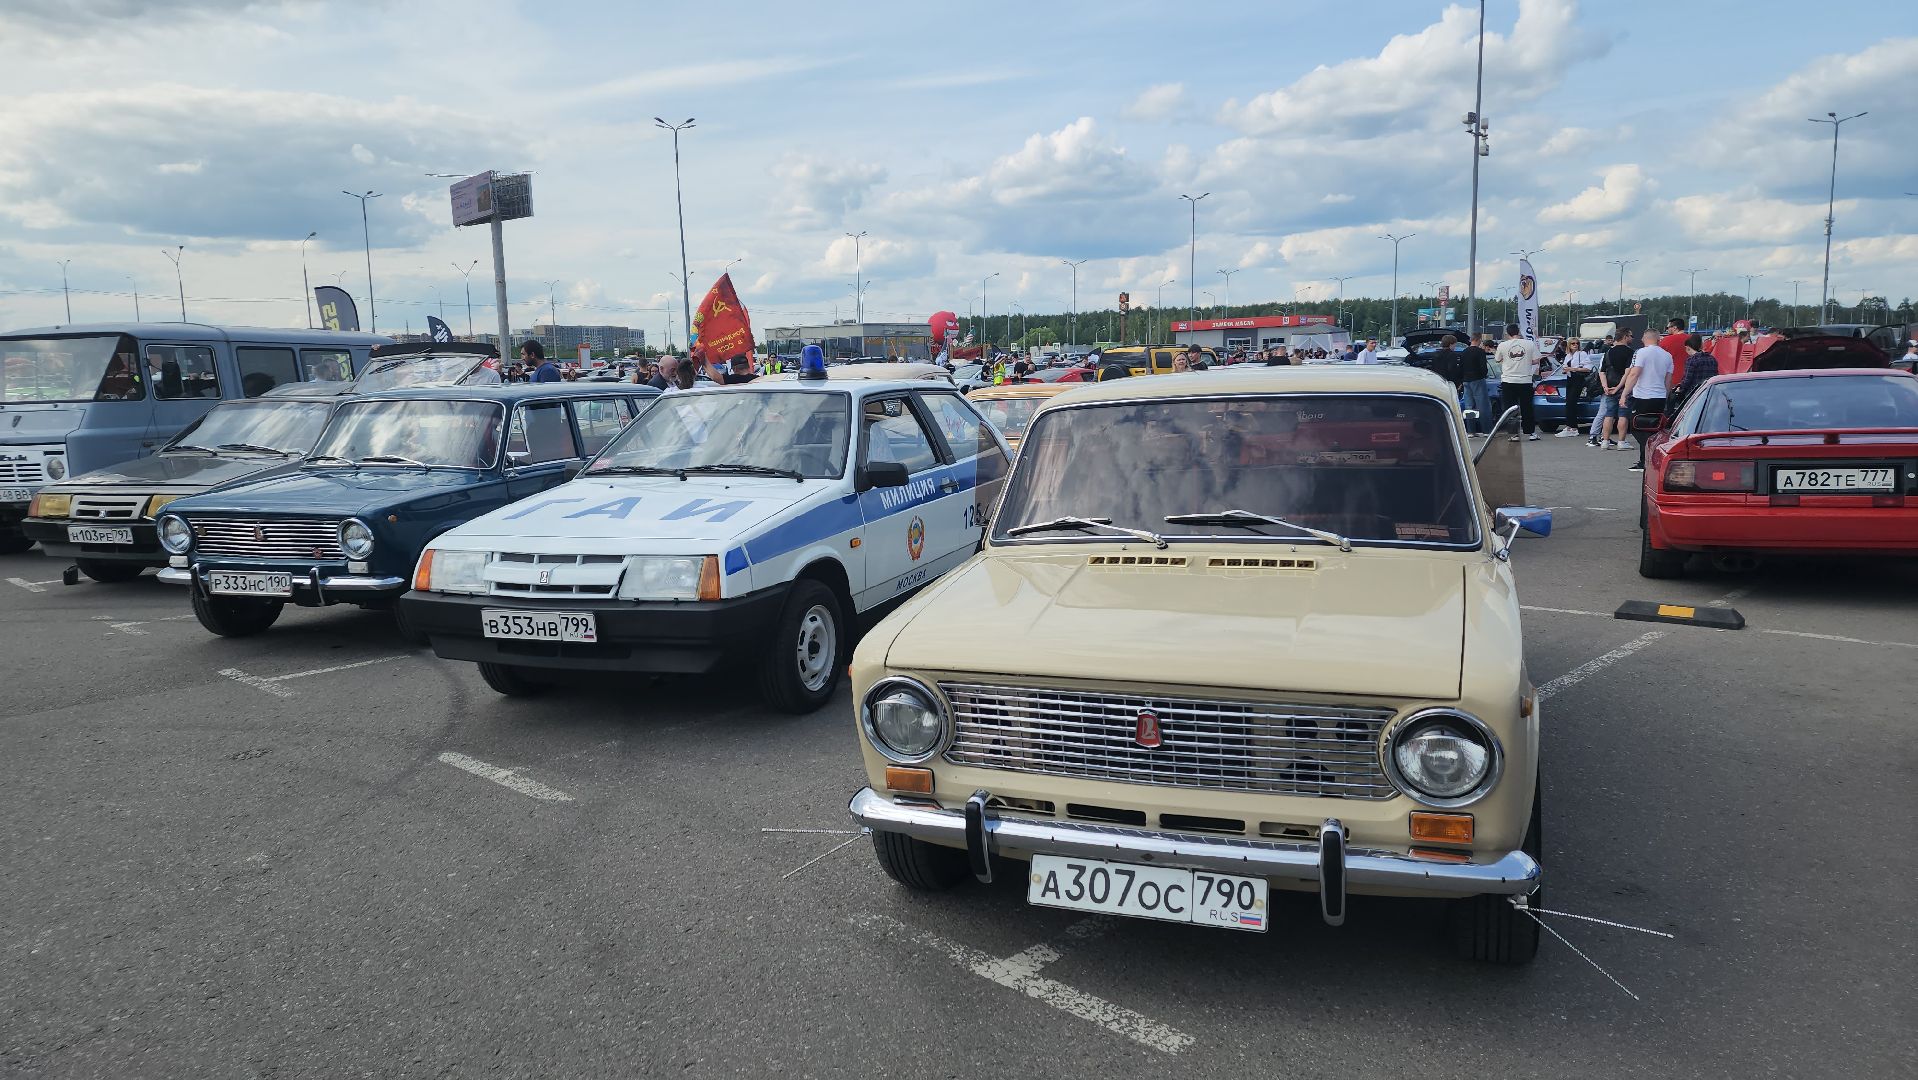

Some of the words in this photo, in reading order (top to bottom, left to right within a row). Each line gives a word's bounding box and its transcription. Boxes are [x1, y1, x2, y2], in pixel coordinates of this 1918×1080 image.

[1783, 472, 1856, 488] А782ТЕ
[1860, 470, 1889, 482] 777
[880, 477, 936, 510] МИЛИЦИЯ
[502, 496, 754, 523] ГАИ
[214, 575, 265, 591] Р333НС
[267, 575, 287, 588] 190
[896, 568, 927, 591] МОСКВА
[489, 615, 559, 637] В353НВ
[560, 616, 589, 633] 799
[1041, 863, 1186, 914] А307ОС
[1196, 875, 1255, 911] 790
[1210, 909, 1239, 923] RUS
